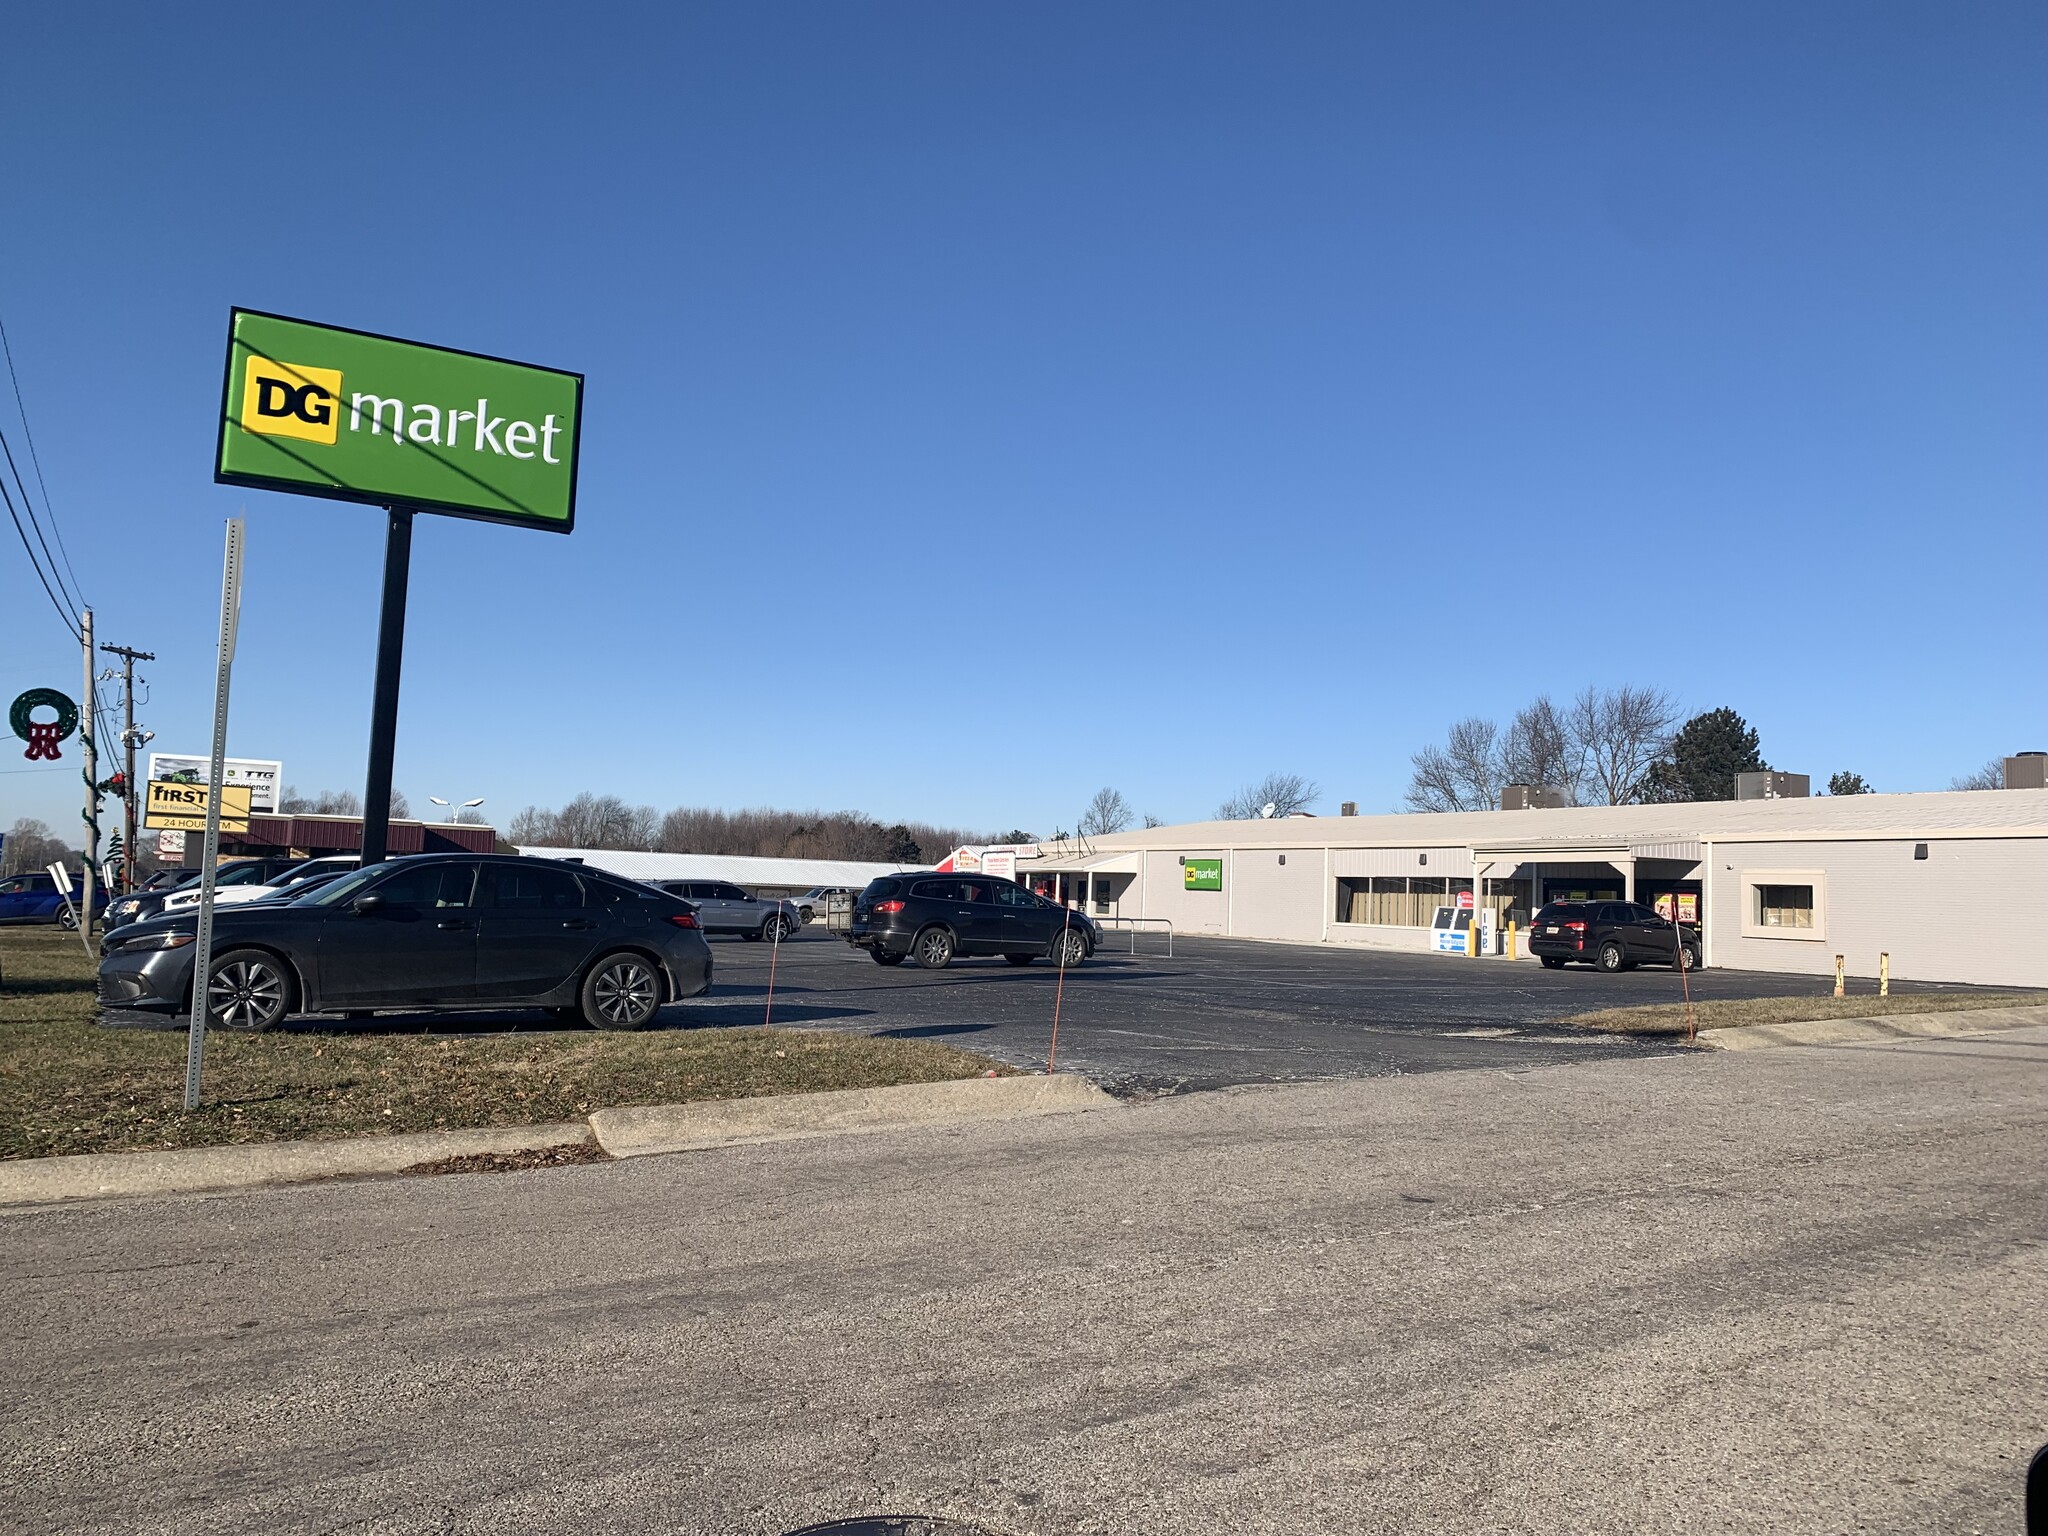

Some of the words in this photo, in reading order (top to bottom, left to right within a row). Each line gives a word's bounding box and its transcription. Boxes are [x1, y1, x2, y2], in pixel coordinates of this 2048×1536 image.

[256, 375, 331, 426] DG
[349, 392, 563, 465] market
[245, 771, 275, 779] TTG
[163, 818, 175, 826] 24
[1018, 846, 1036, 855] STORE
[1196, 868, 1218, 879] market
